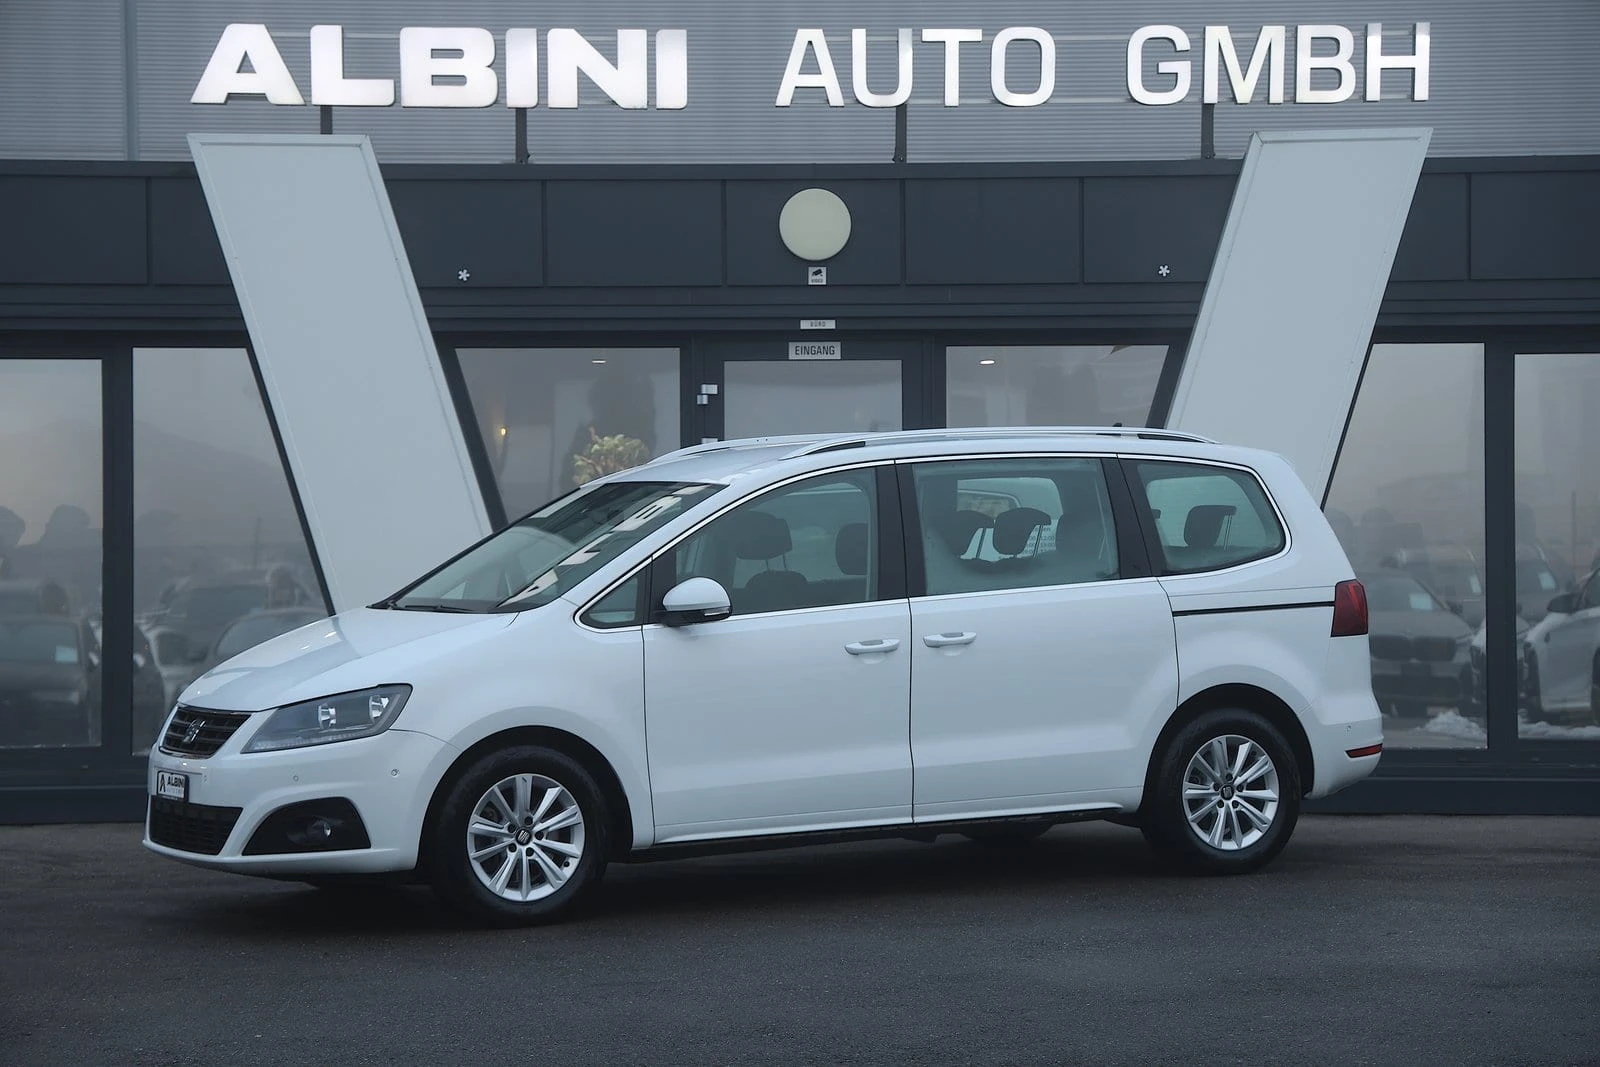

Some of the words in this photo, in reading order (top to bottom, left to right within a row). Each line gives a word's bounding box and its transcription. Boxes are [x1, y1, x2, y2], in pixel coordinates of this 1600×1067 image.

[190, 23, 689, 109] ALBINI
[775, 27, 1057, 108] AUTO
[1127, 22, 1431, 105] GMBH
[794, 345, 836, 356] EINGANG
